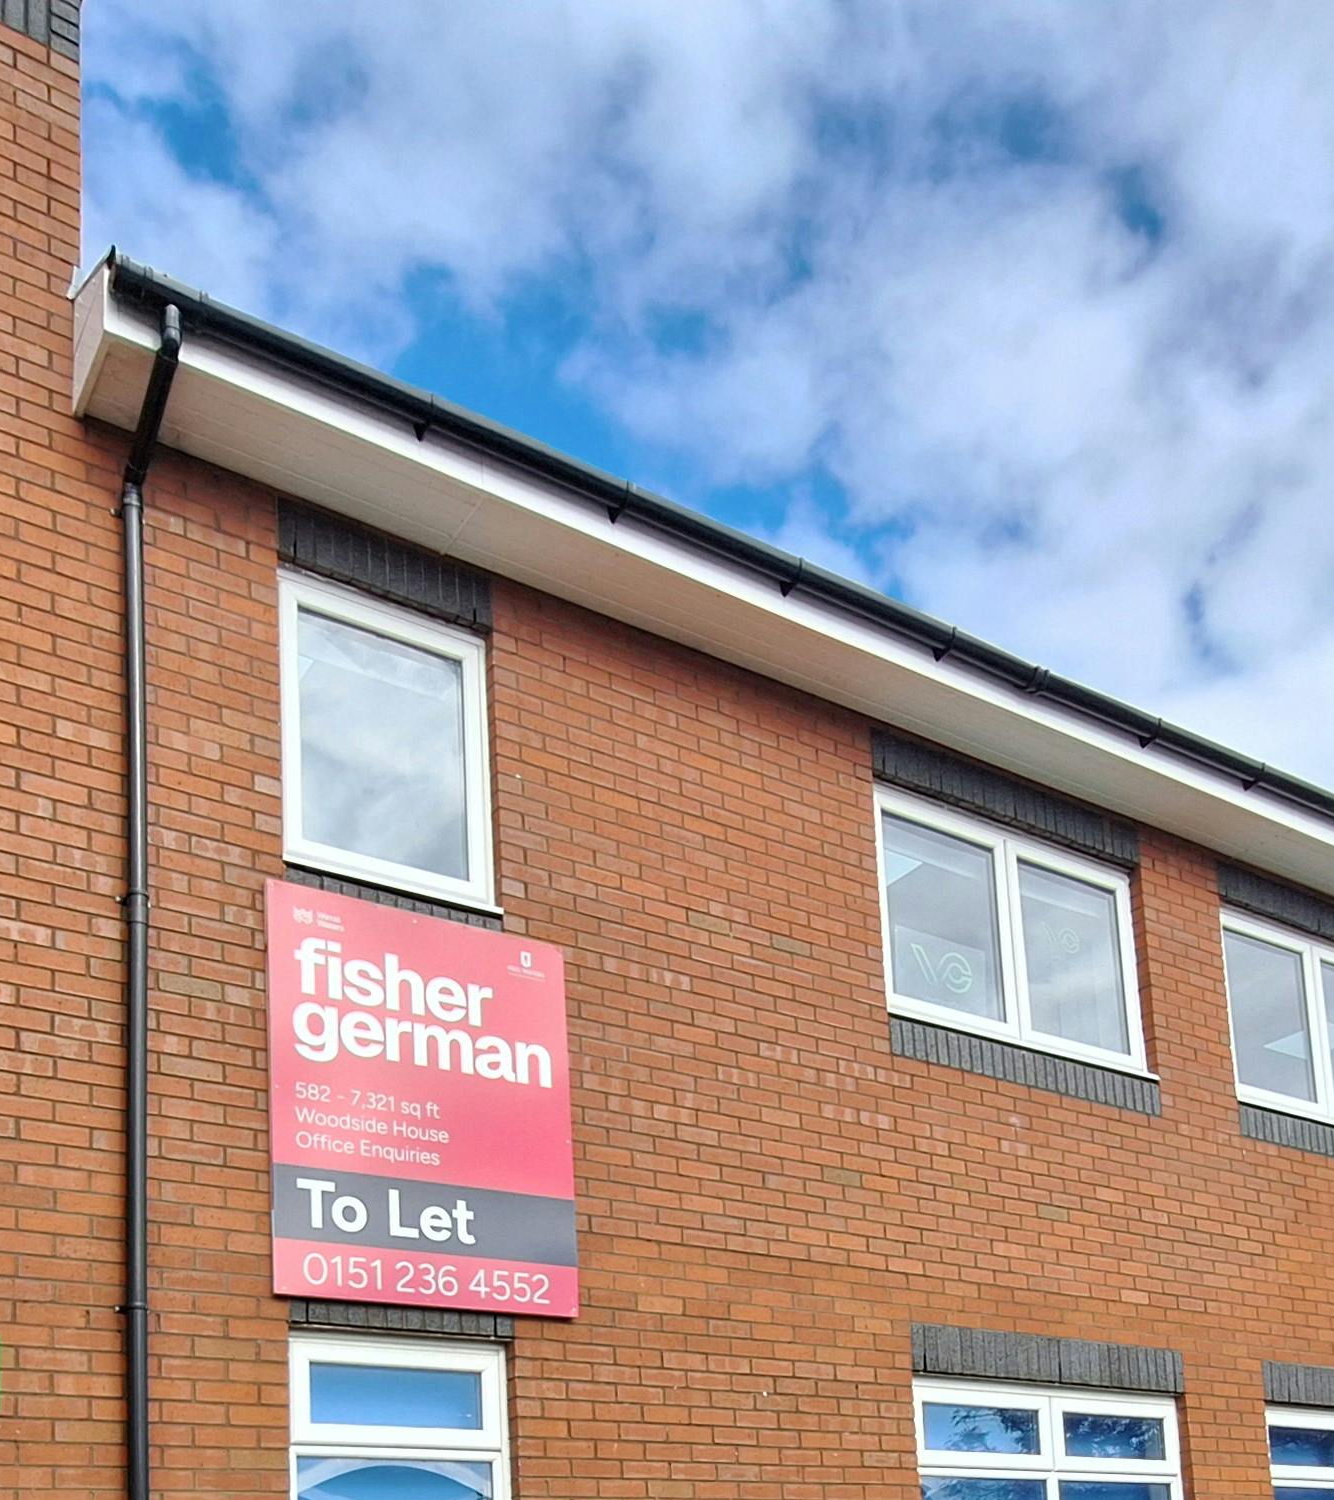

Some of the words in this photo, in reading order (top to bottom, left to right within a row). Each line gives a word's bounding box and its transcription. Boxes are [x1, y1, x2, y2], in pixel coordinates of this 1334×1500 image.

[294, 937, 493, 1026] fisher
[292, 1002, 552, 1088] german
[295, 1082, 331, 1103] 582
[401, 1099, 421, 1119] sq
[426, 1101, 441, 1119] ft
[295, 1106, 388, 1137] Woodside
[393, 1120, 449, 1143] House
[296, 1133, 354, 1154] Office
[361, 1142, 440, 1165] Enquiries
[297, 1178, 367, 1231] To
[389, 1189, 476, 1244] Let
[303, 1253, 382, 1289] 0151
[396, 1261, 457, 1296] 236
[469, 1269, 549, 1303] 4552
